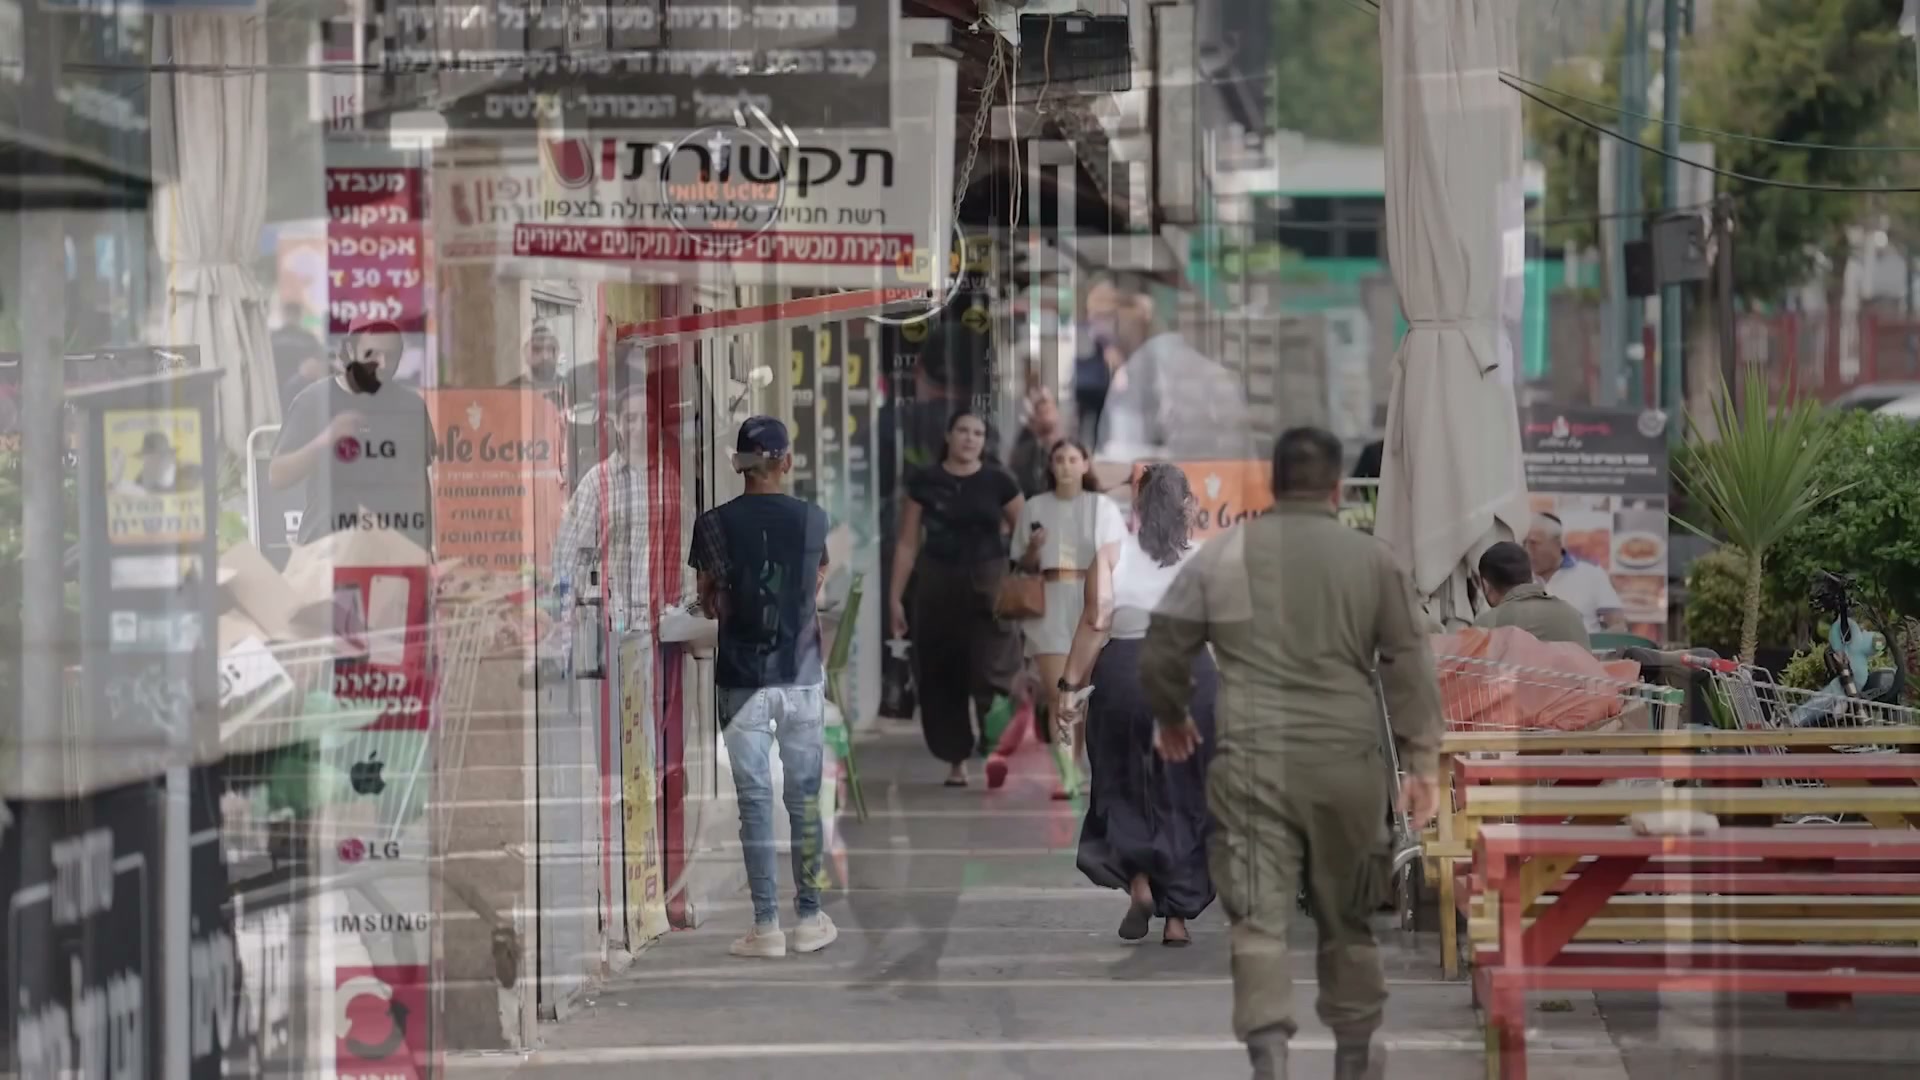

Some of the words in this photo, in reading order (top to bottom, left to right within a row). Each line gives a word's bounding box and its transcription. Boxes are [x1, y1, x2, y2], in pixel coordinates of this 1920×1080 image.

[351, 267, 381, 288] 30
[364, 440, 397, 459] LG
[331, 511, 426, 530] MSUNG
[368, 840, 400, 860] LG
[334, 914, 428, 933] MSUNG
